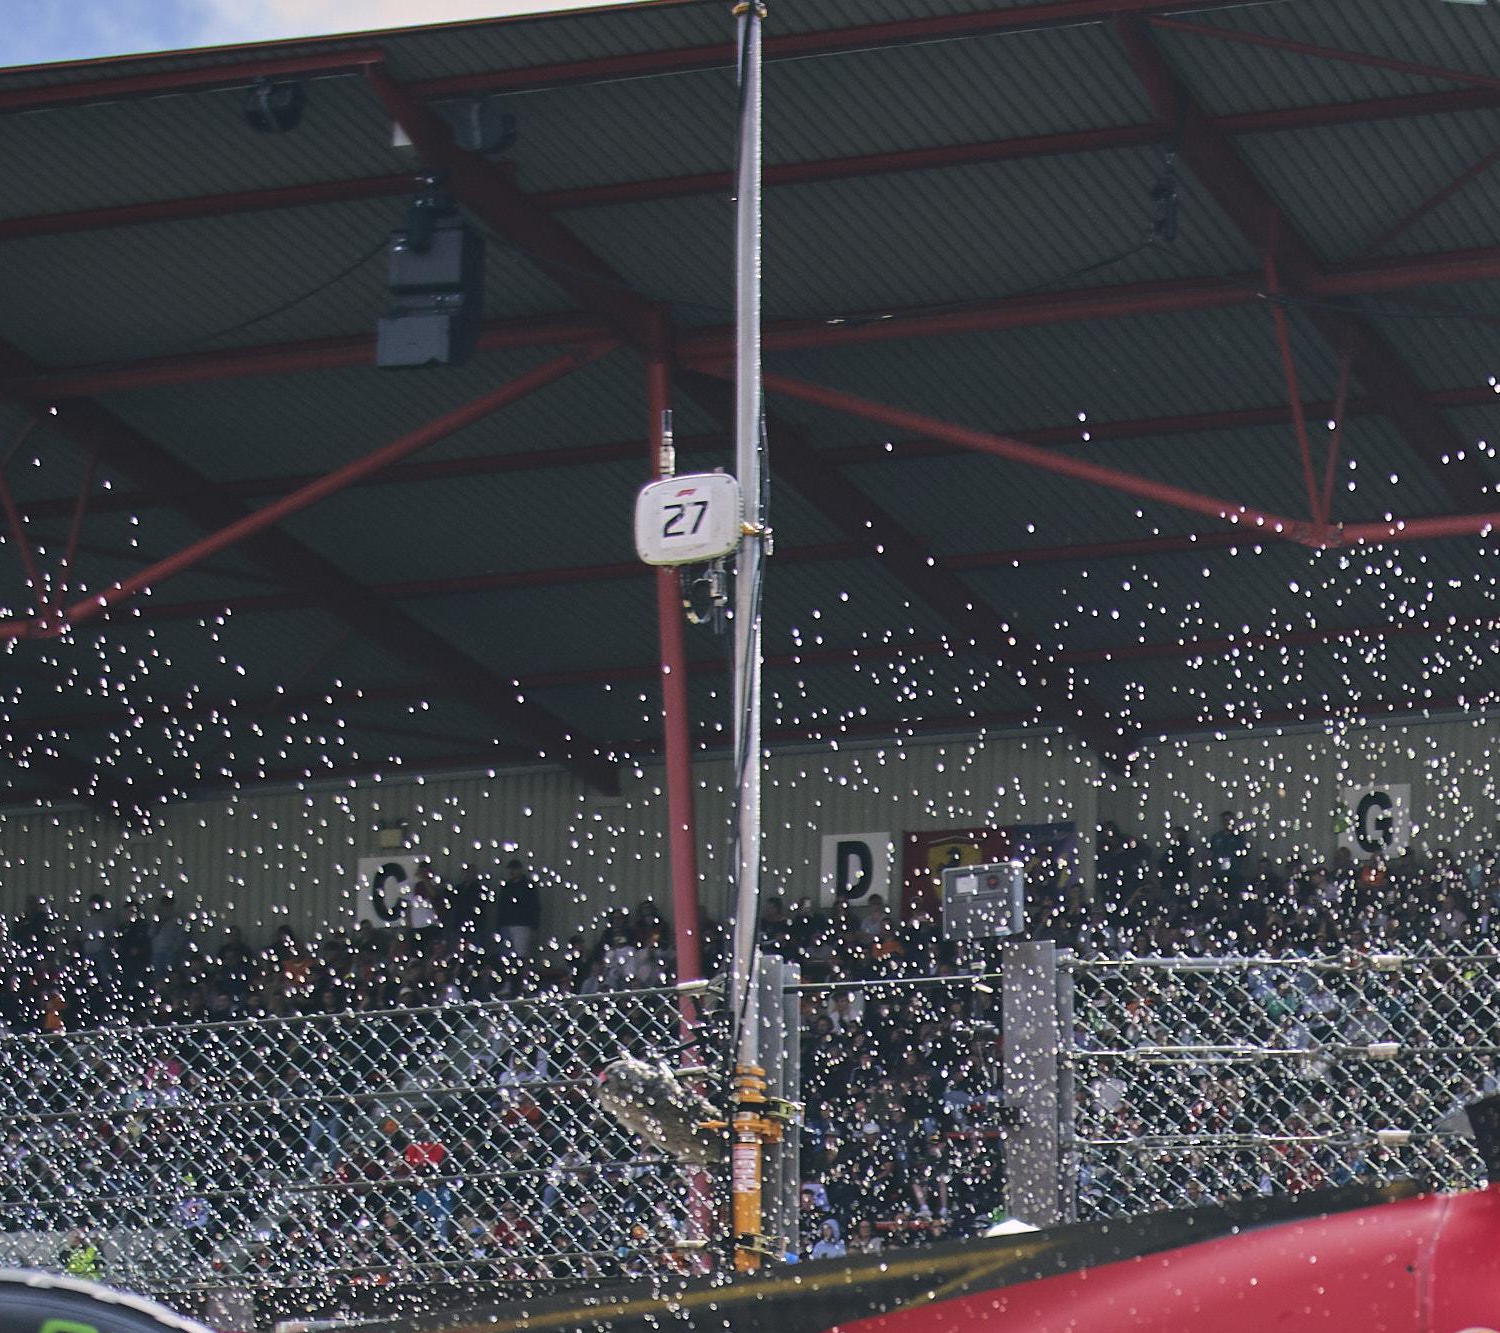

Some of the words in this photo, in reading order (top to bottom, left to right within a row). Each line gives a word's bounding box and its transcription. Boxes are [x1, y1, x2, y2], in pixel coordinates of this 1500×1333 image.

[663, 500, 709, 538] 27
[1355, 791, 1393, 854] G
[837, 841, 873, 900] D
